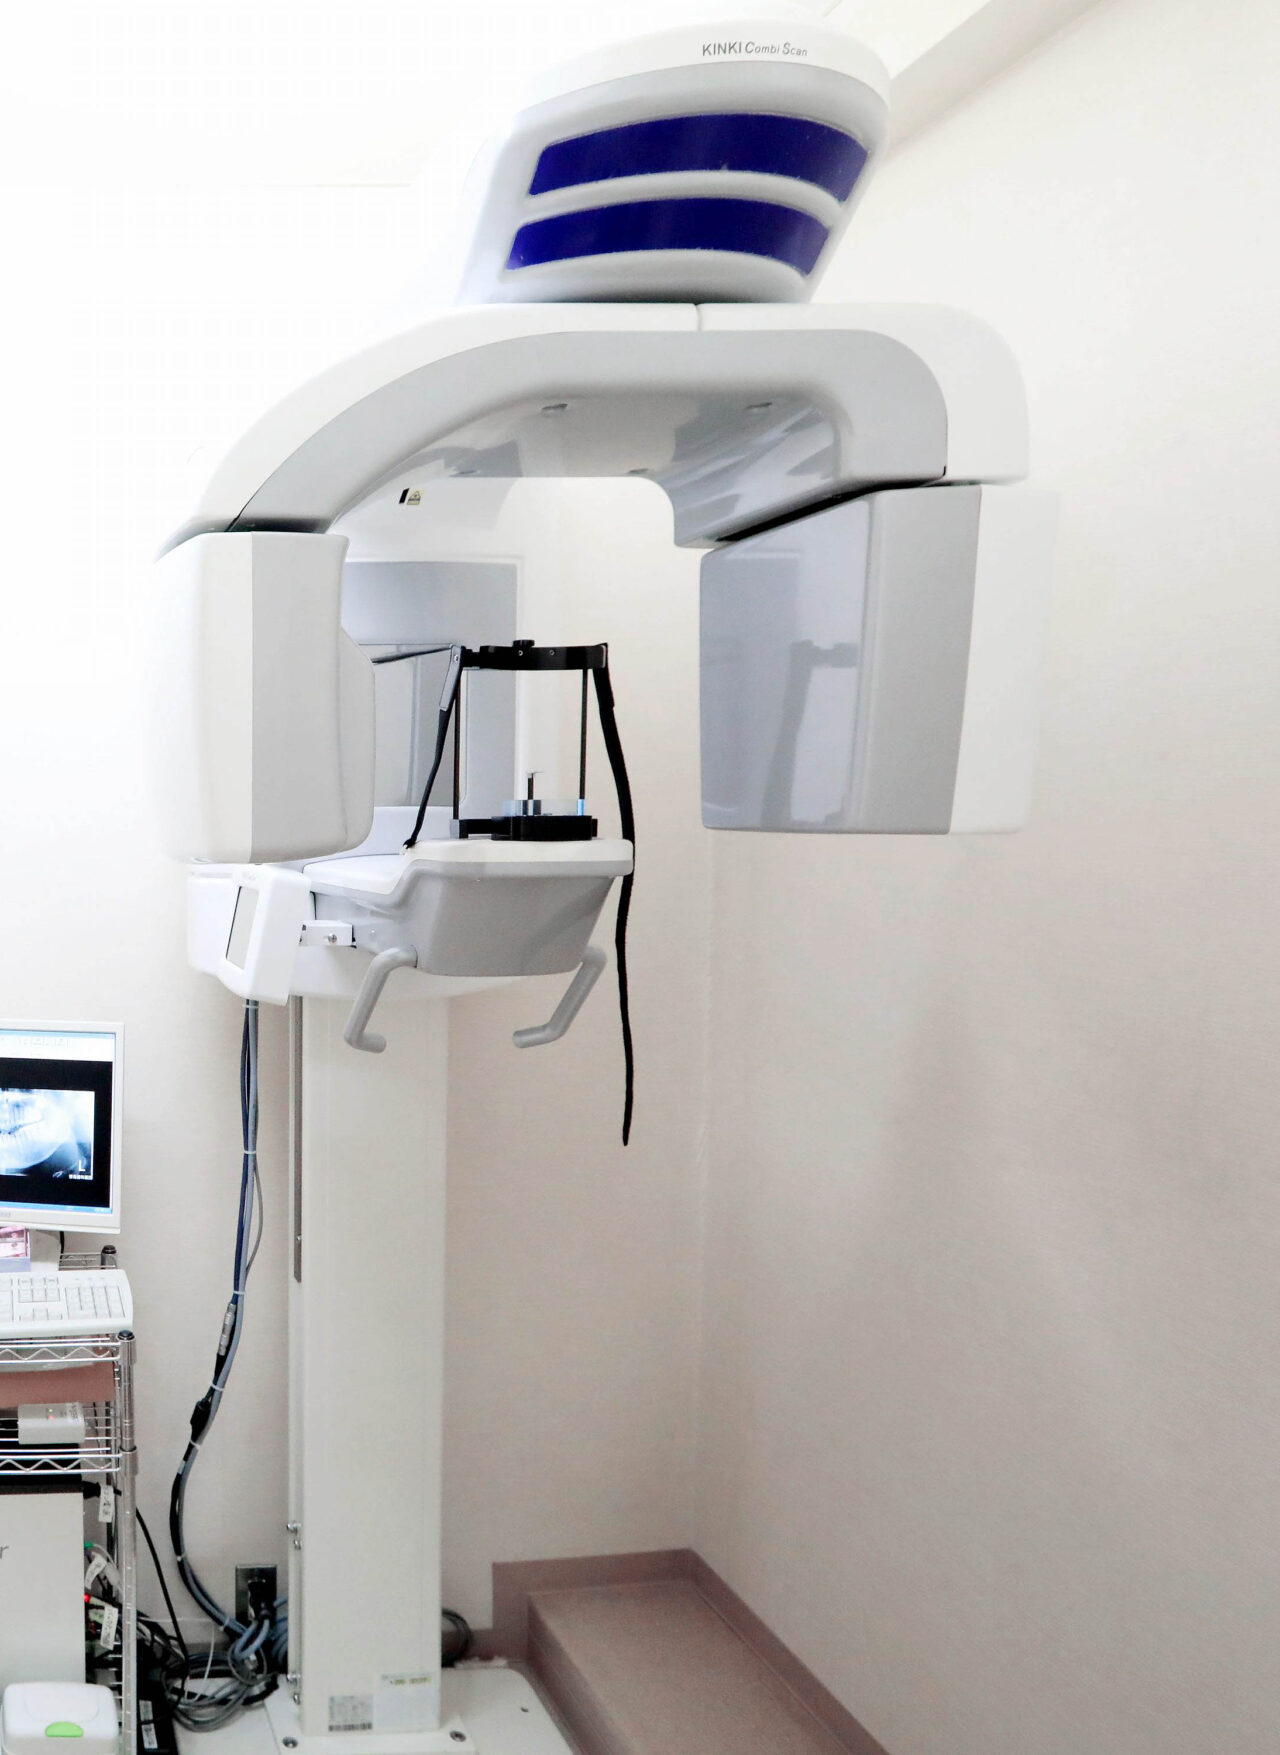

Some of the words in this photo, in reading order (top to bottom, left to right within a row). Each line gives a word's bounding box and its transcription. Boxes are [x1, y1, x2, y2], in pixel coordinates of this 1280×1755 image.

[702, 41, 742, 57] KINKI
[744, 41, 780, 55] Combi
[782, 42, 808, 56] Scan
[78, 1159, 86, 1172] L
